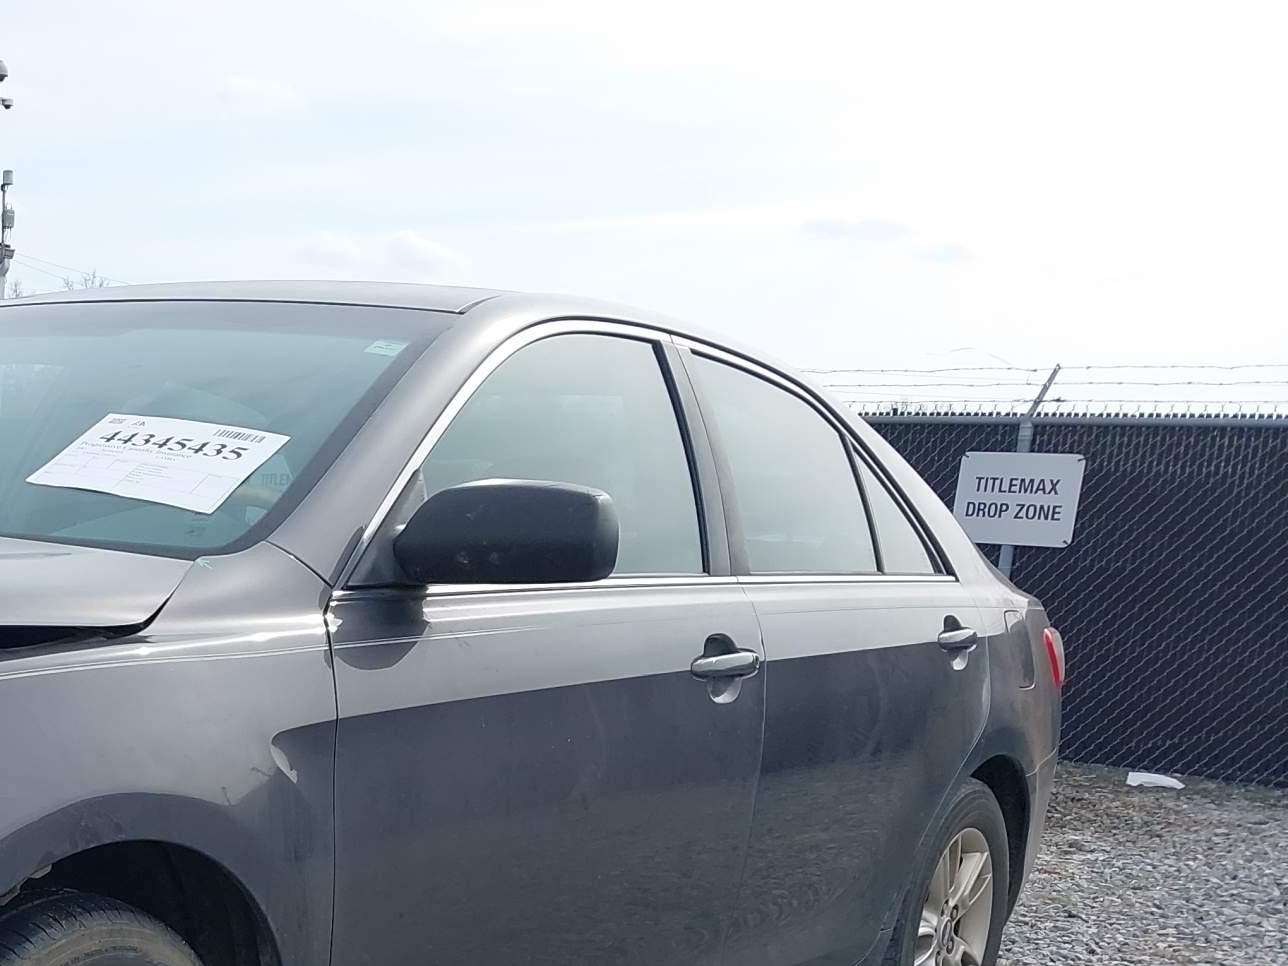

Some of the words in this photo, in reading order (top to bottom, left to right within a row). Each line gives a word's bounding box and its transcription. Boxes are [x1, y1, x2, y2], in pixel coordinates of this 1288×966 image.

[99, 430, 249, 460] 44345435
[975, 476, 1061, 495] TITLEMAX
[965, 501, 1010, 519] DROP
[1013, 503, 1063, 521] ZONE
